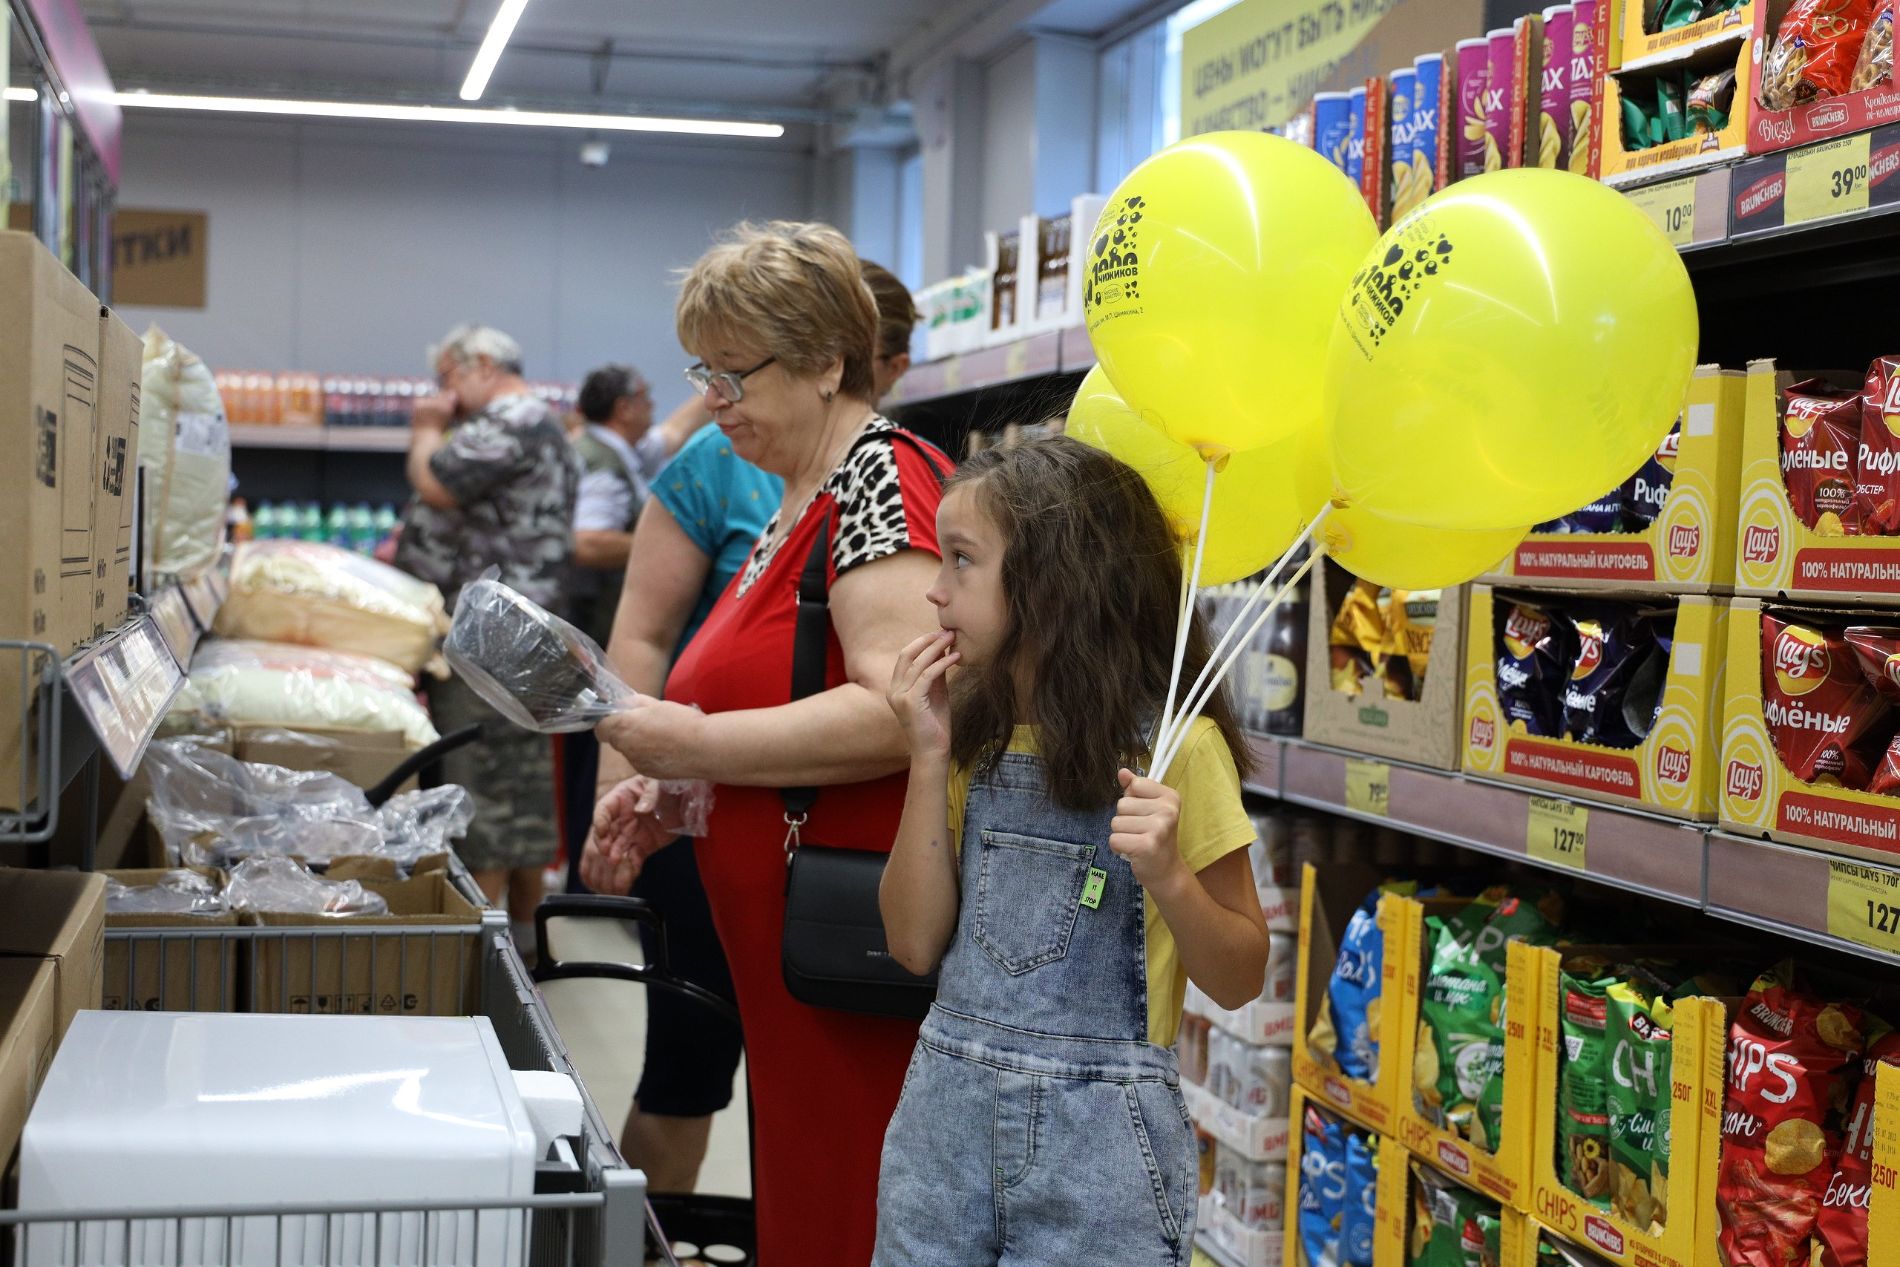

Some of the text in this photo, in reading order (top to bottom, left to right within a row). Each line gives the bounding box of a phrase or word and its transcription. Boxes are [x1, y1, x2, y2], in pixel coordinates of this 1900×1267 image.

[1759, 112, 1796, 144] Brezel
[1811, 110, 1846, 128] BRUNCHERS
[1816, 142, 1841, 155] BRUNCHERS
[1831, 164, 1867, 199] 39 00
[1740, 179, 1783, 217] BRUNCHERS
[1666, 203, 1692, 232] 10 00
[1098, 266, 1138, 284] ЧИЖИКОВ
[1365, 283, 1397, 327] ЧИЖИКОВ
[1670, 526, 1699, 557] Lay's
[1745, 526, 1779, 564] Lay's
[1519, 550, 1649, 571] 100% НАТУРАЛЬНЫЙ КАРТОФЕЛЬ
[1801, 561, 1828, 578] 100%
[1775, 632, 1826, 679] Lay's
[1529, 753, 1585, 777] НАТУРАЛЬНЫЙ
[1585, 765, 1635, 788] КАРТОФЕЛЬ
[1659, 746, 1691, 782] Lay's
[1728, 761, 1762, 801] Lay's
[1785, 803, 1897, 841] 100% НАТУРАЛЬНЫЙ
[1554, 827, 1576, 853] 127
[1830, 860, 1859, 877] ЧИПСЫ
[1860, 868, 1880, 883] LAYS
[1882, 873, 1900, 889] 170Г
[1084, 896, 1097, 905] STOP
[1867, 900, 1900, 935] 127
[1672, 1081, 1693, 1103] 250Г
[1705, 1087, 1718, 1110] XXL
[1873, 1163, 1897, 1190] 250Г
[1587, 1222, 1622, 1253] BRUNCHERS
